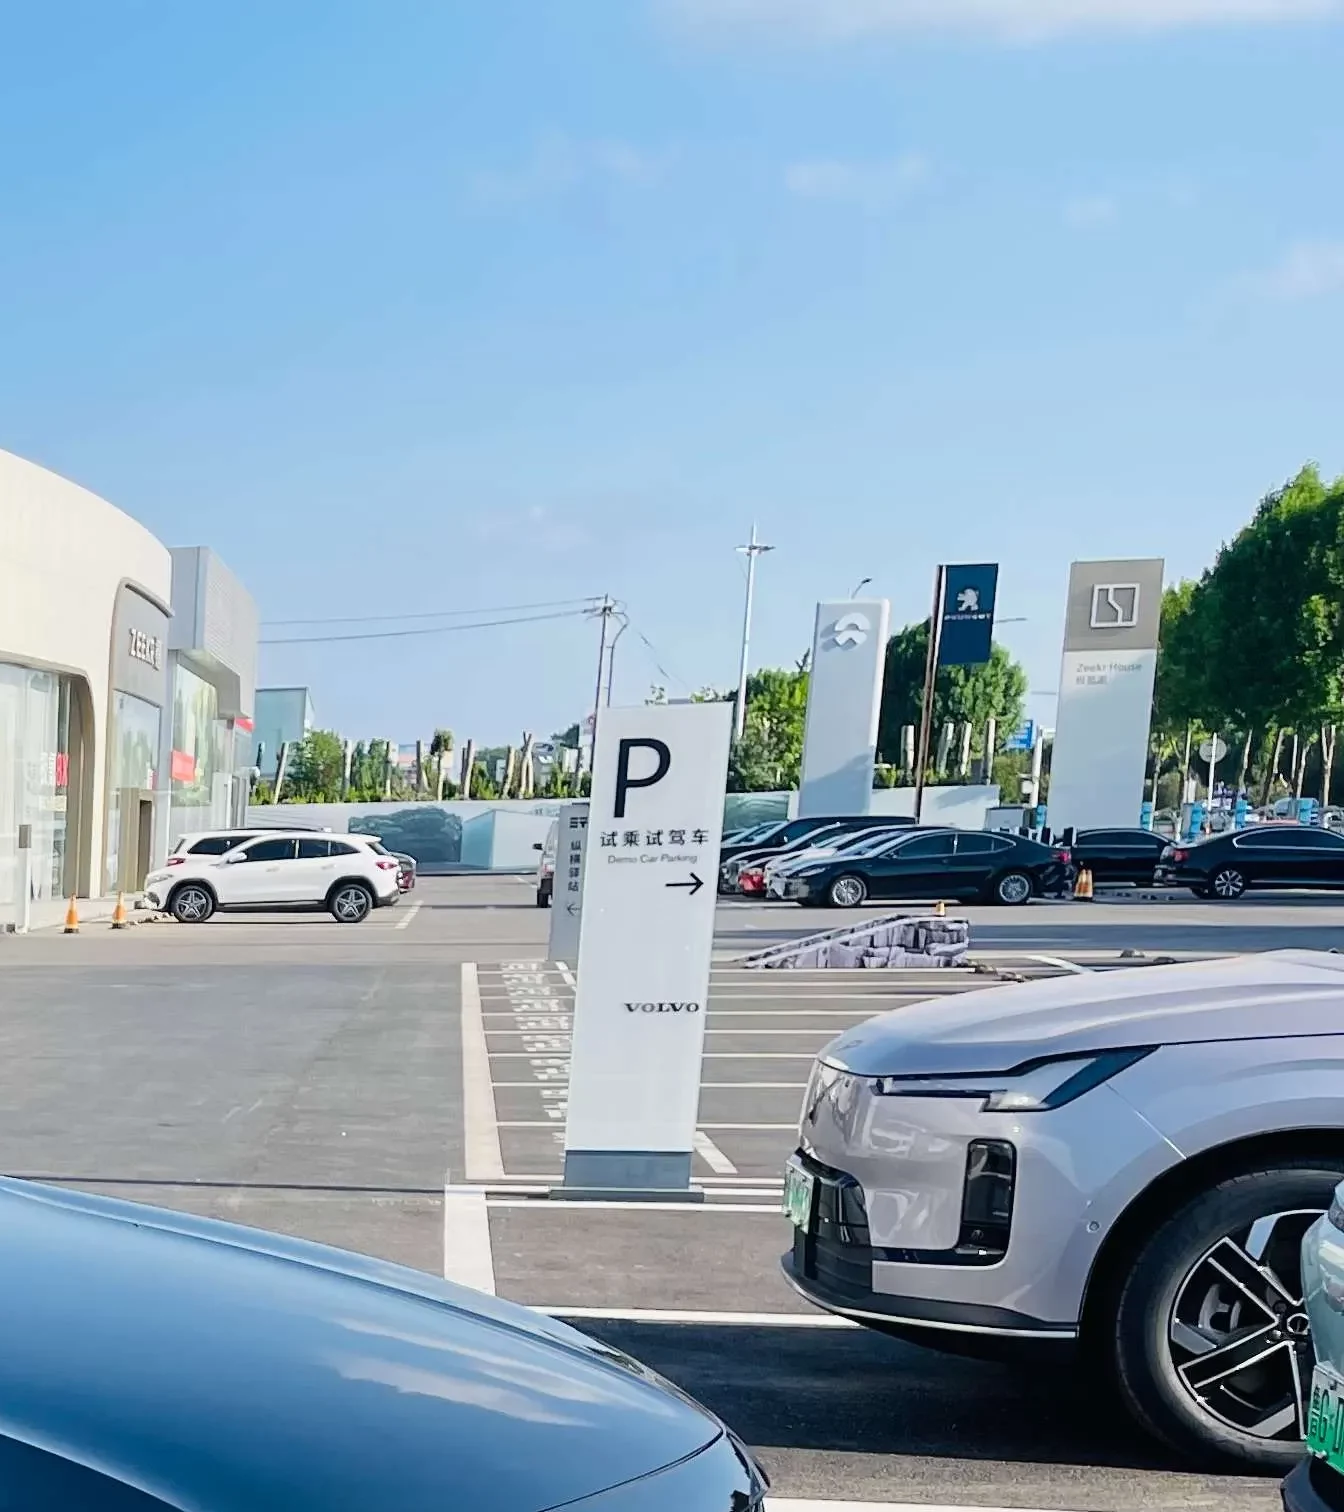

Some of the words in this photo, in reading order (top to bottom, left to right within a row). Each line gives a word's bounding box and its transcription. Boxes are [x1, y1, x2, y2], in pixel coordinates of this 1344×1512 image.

[613, 737, 672, 818] P
[600, 829, 710, 847] 试乘试驾车
[607, 854, 638, 864] Demo
[639, 854, 659, 864] Car
[660, 853, 698, 865] Parking
[623, 1002, 700, 1013] VOLVO
